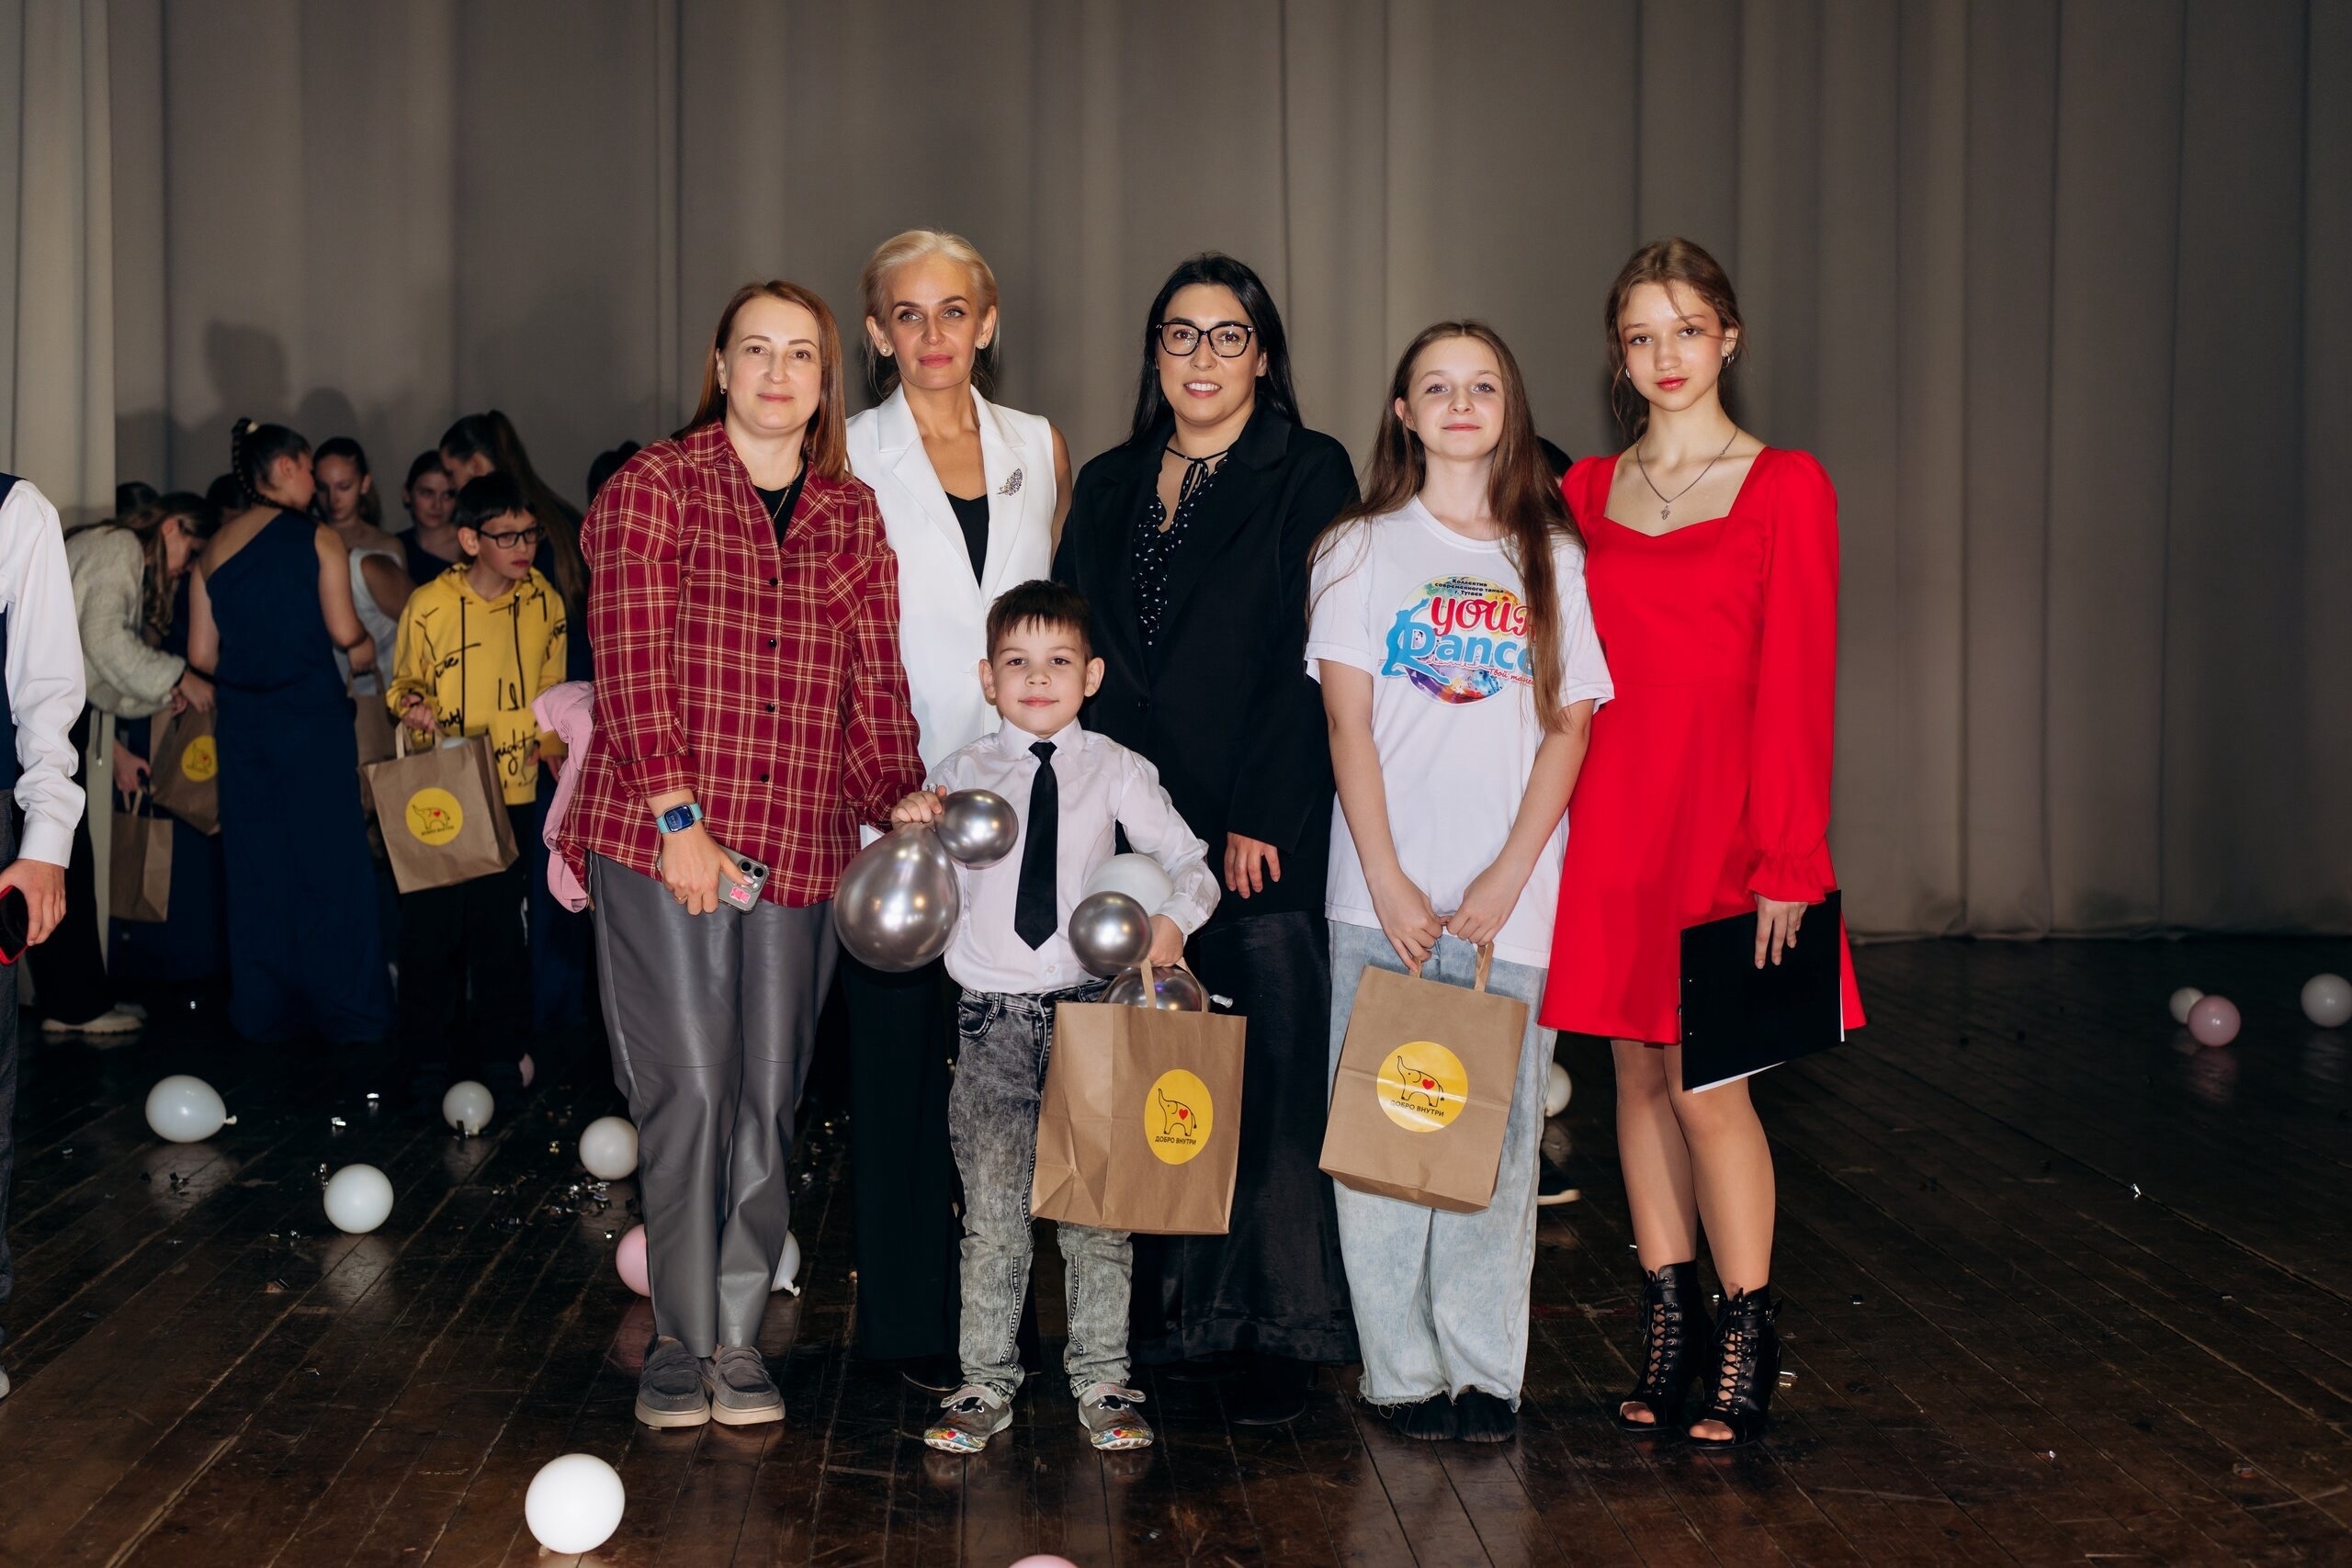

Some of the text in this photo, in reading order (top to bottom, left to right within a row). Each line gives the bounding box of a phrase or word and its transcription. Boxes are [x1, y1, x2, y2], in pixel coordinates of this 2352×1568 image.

[1389, 1100, 1445, 1118] ДОБРО ВНУТРИ
[1155, 1135, 1197, 1145] ДОБРО ВНУТРИ
